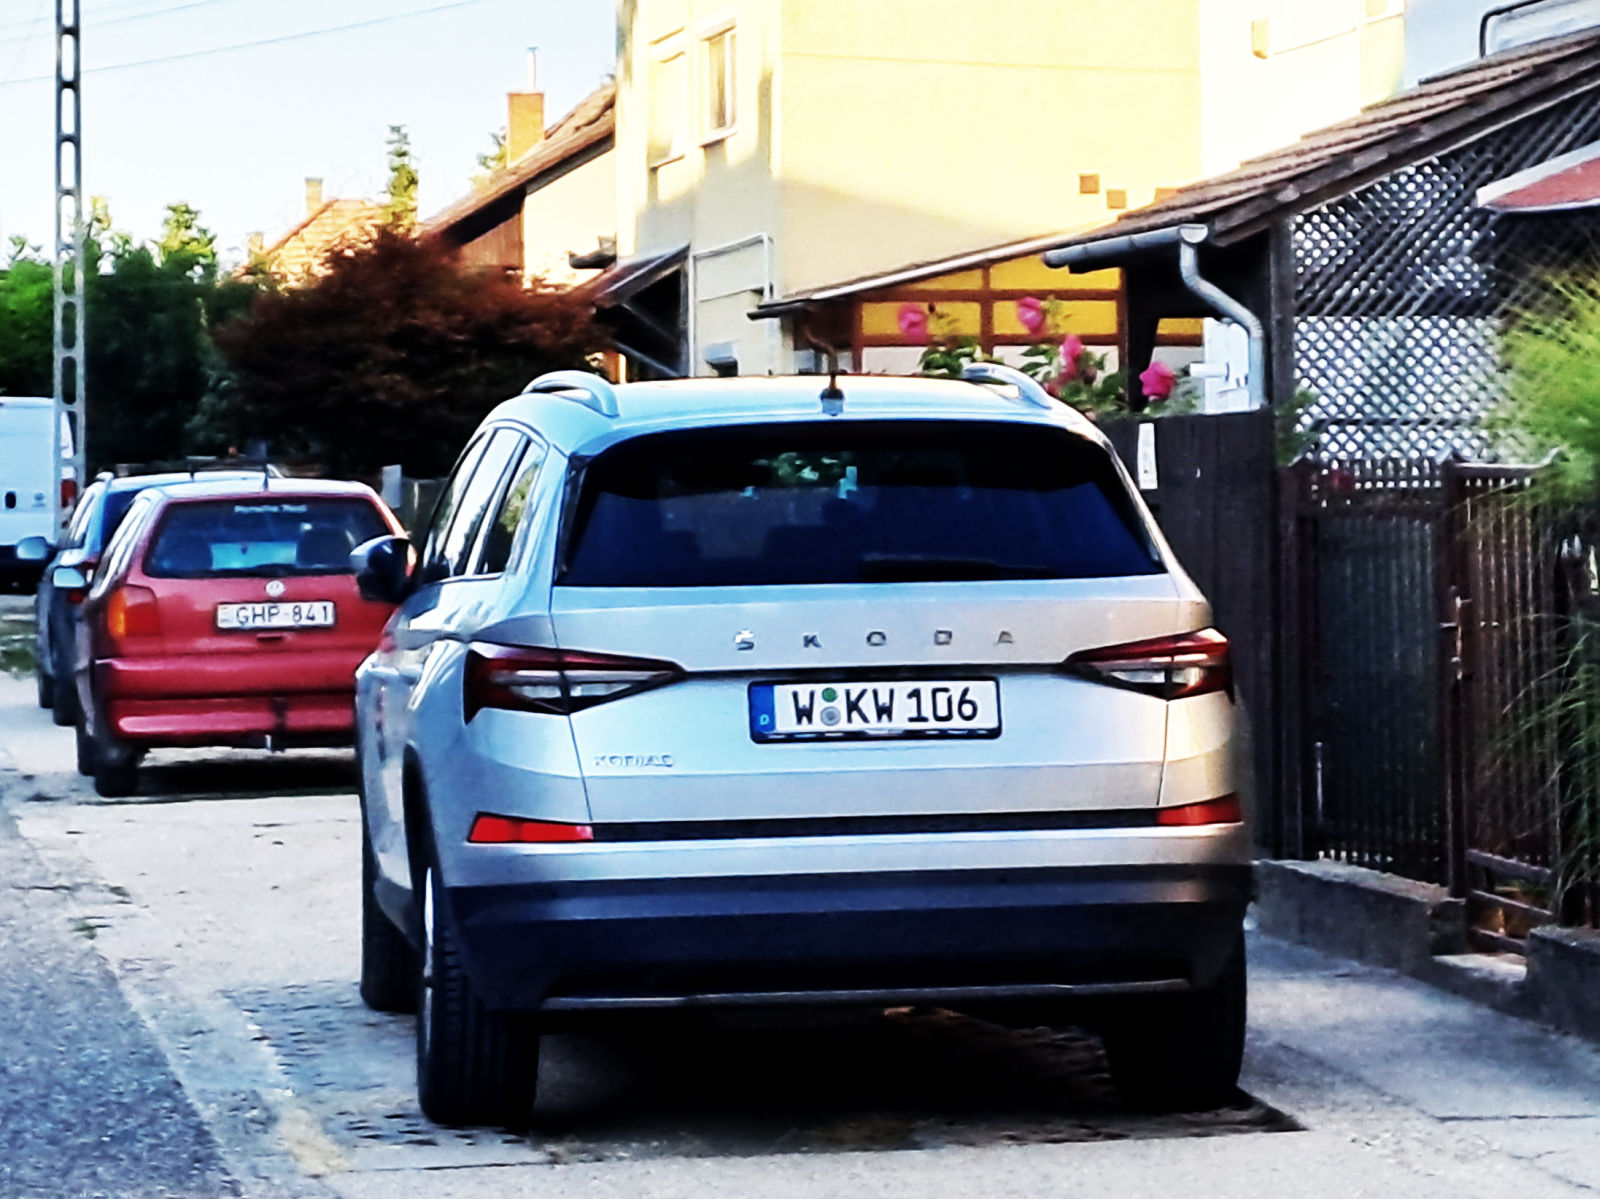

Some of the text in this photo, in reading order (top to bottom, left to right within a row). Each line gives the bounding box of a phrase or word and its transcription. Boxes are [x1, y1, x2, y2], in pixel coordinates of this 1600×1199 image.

[760, 687, 978, 725] D W KW 106
